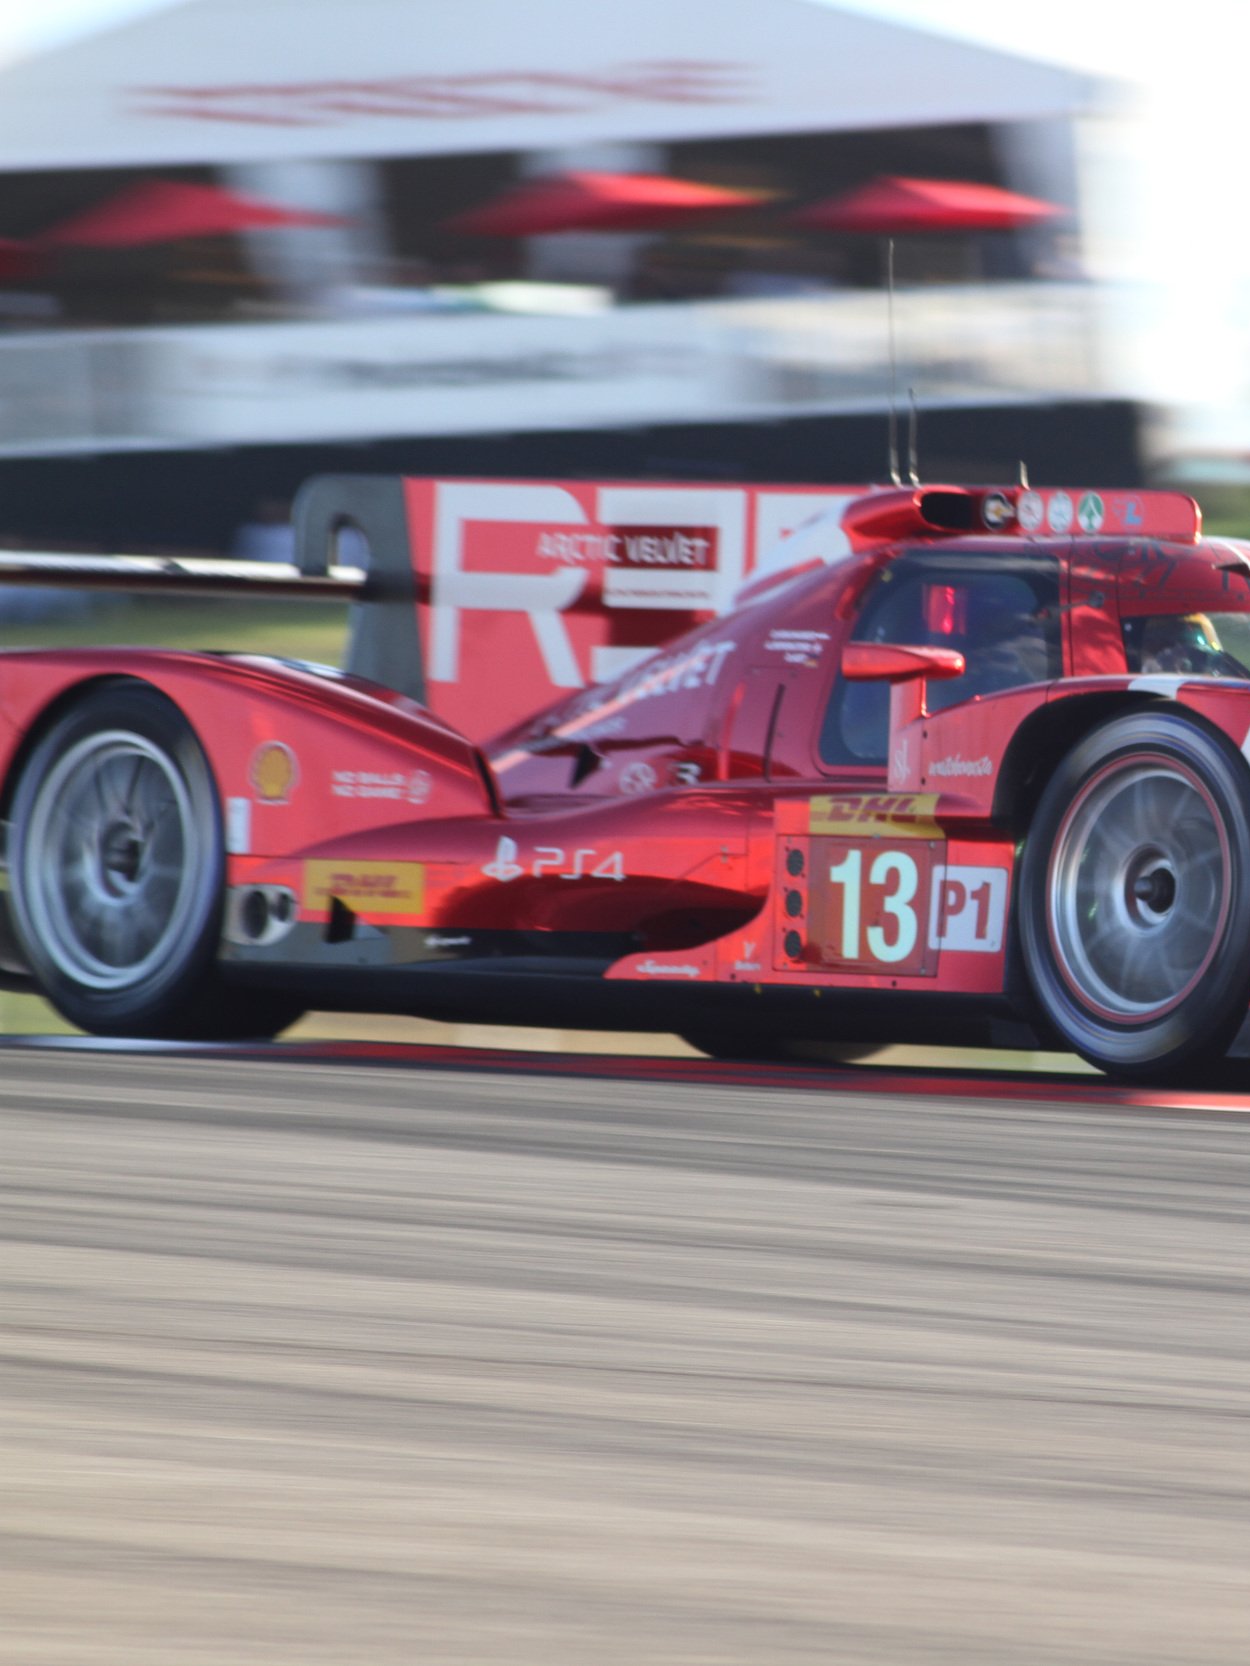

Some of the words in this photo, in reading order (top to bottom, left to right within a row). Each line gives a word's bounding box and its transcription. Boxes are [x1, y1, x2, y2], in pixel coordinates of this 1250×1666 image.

[535, 532, 622, 564] ARCTIC
[624, 531, 710, 565] VELVET
[826, 796, 917, 824] DHL
[532, 846, 626, 881] PS4
[829, 849, 919, 963] 13
[936, 879, 991, 940] P1
